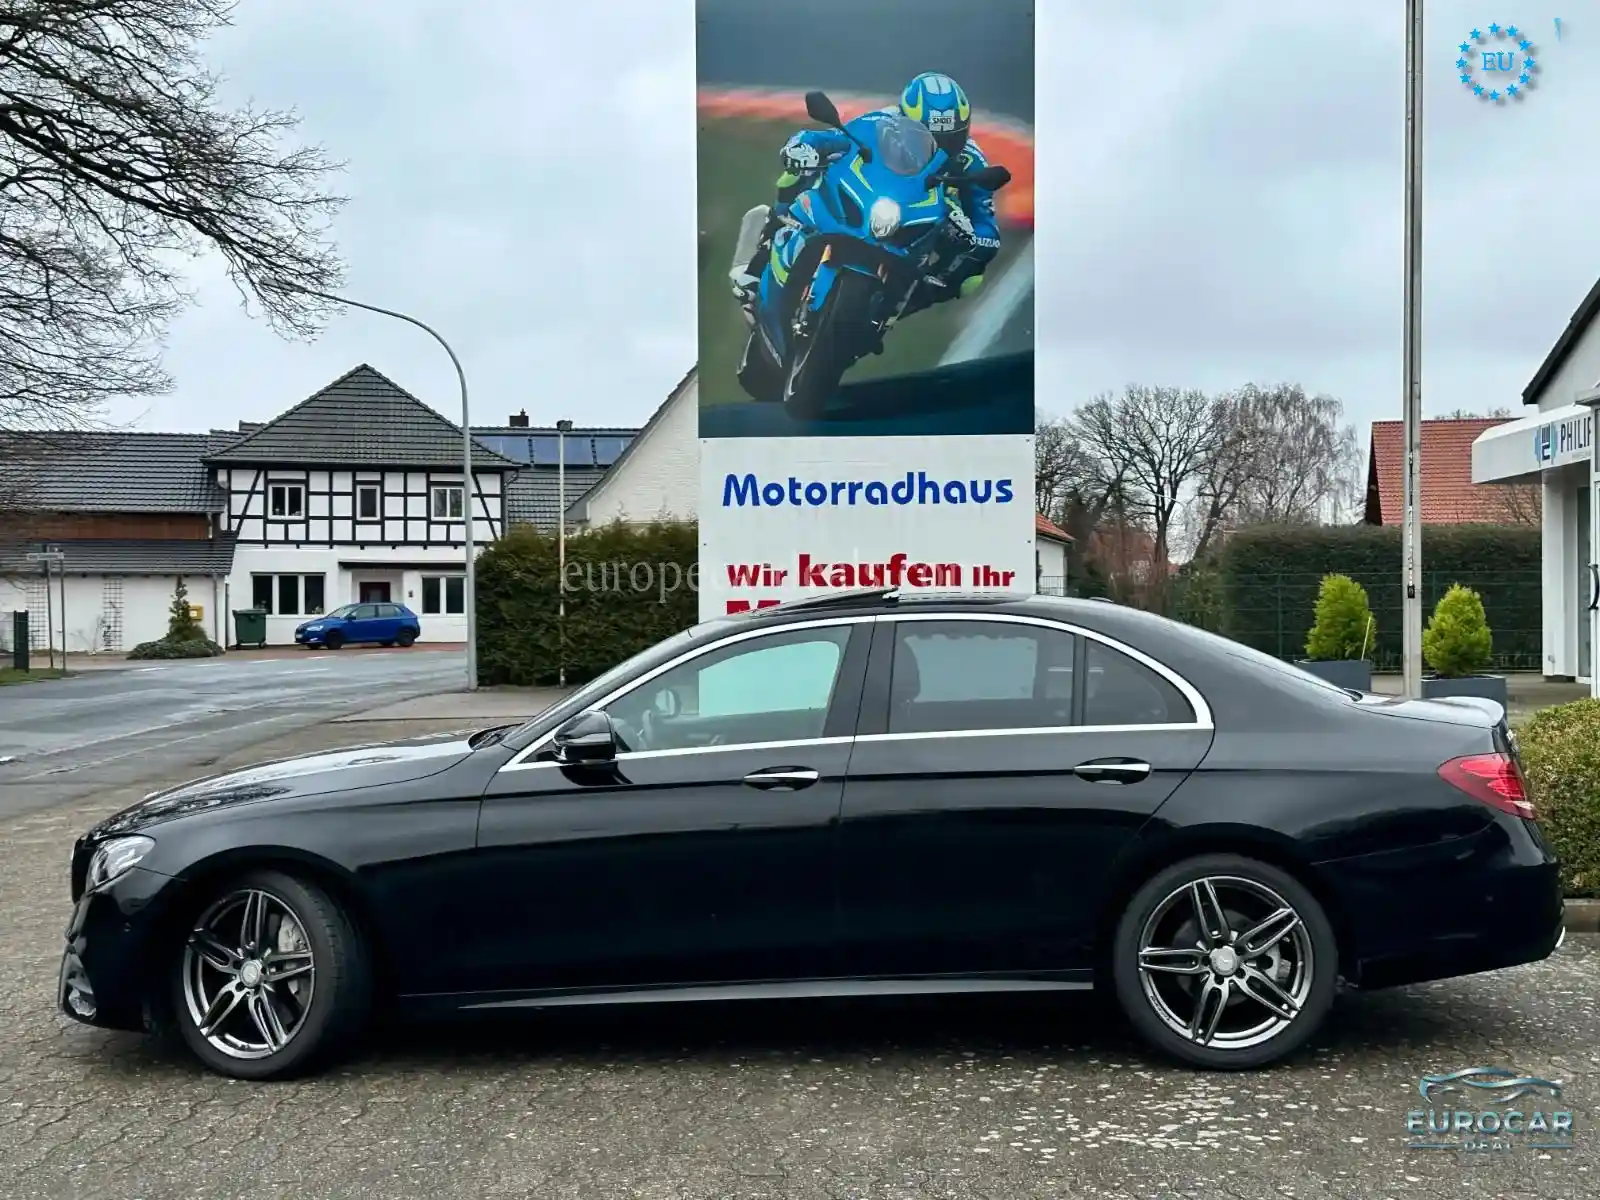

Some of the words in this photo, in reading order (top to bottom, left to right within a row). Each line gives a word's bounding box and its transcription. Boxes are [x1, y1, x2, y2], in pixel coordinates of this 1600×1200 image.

[722, 471, 1014, 507] Motorradhaus
[726, 563, 788, 587] Wir
[798, 552, 962, 588] kaufen
[972, 564, 1016, 587] Ihr
